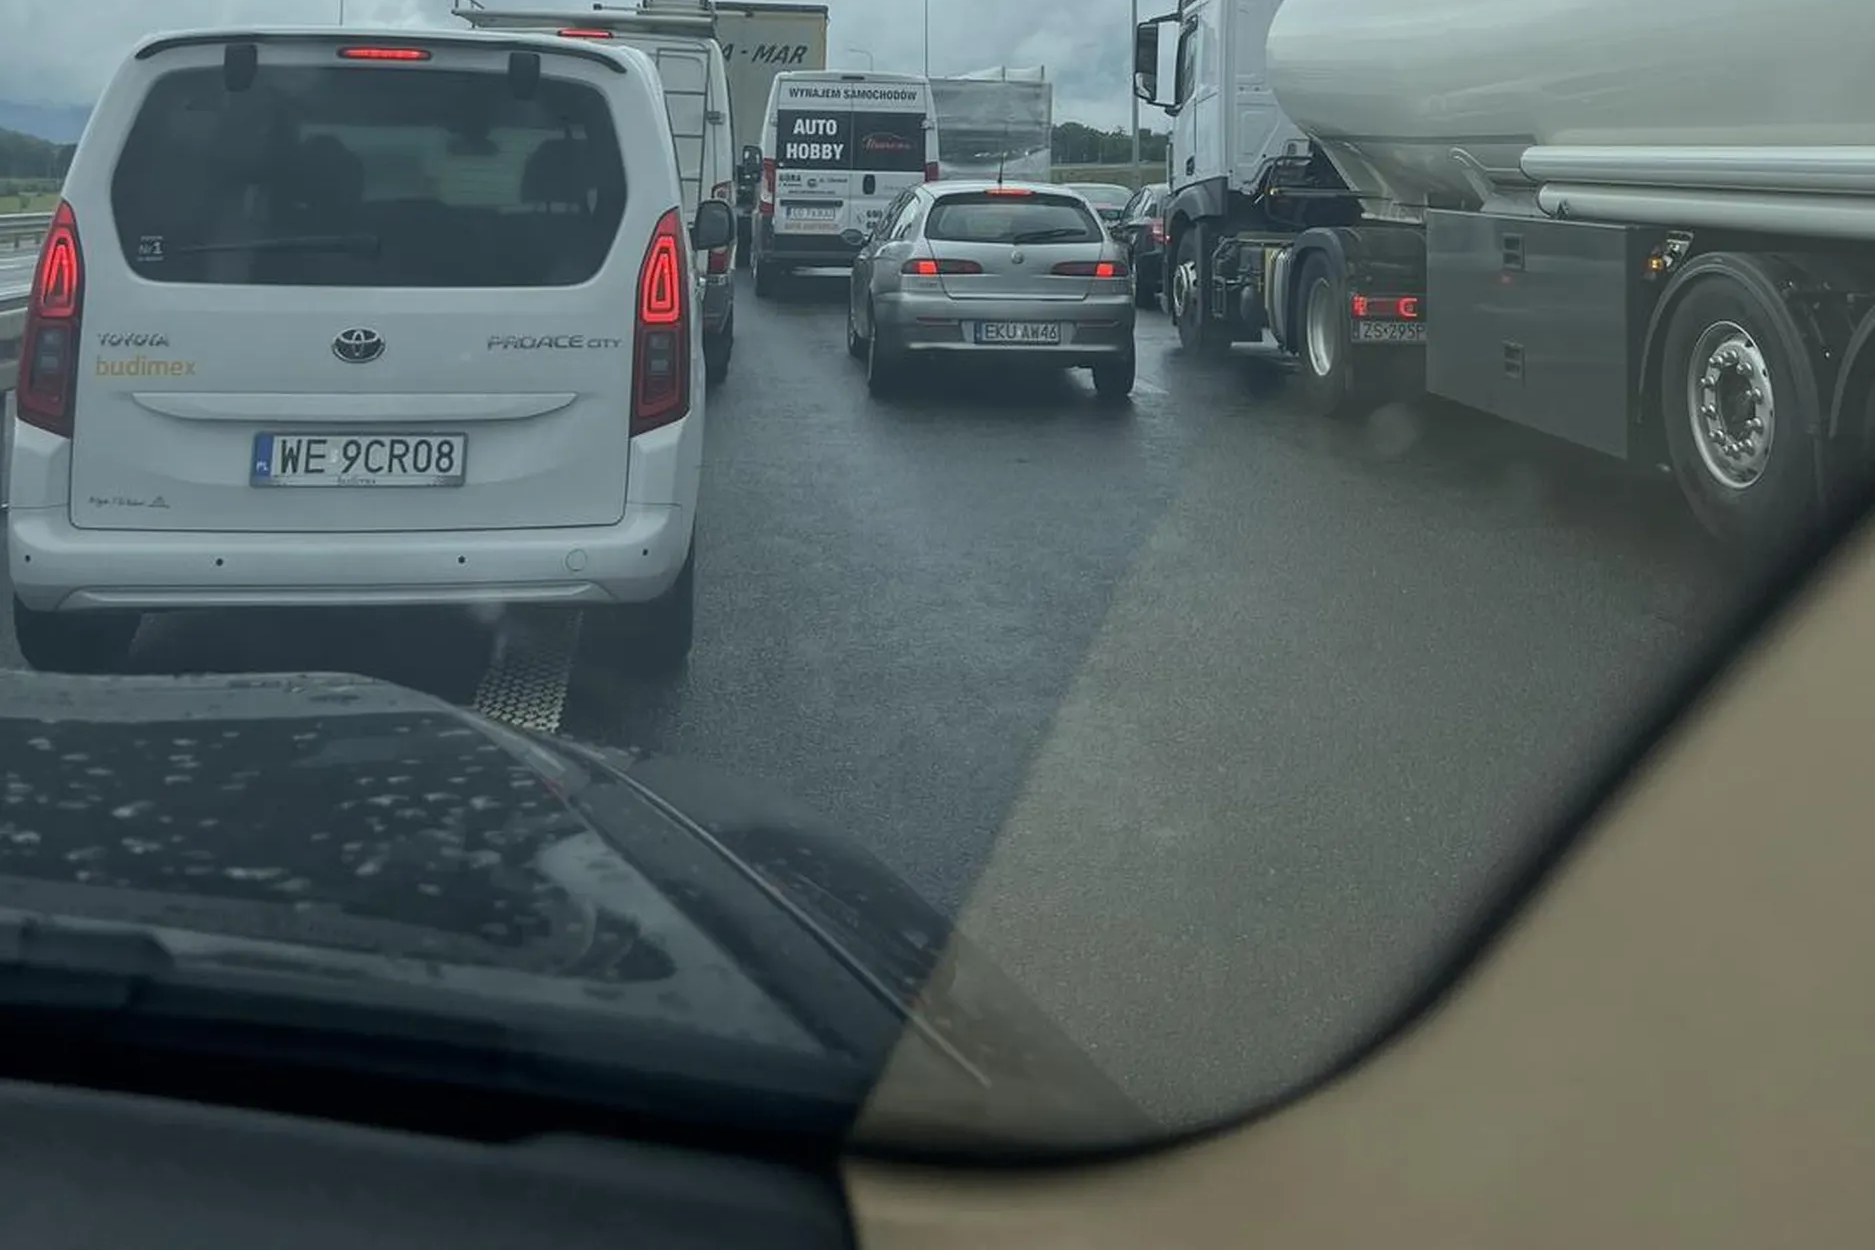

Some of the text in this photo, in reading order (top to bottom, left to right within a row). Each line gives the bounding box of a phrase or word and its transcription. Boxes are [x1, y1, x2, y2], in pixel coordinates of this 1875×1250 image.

[751, 44, 808, 64] MAR
[789, 88, 840, 99] WYNAJEM
[793, 118, 838, 136] AUTO
[786, 142, 844, 160] HOBBY
[97, 332, 169, 347] TOYOTA
[985, 324, 1017, 339] EKU
[487, 335, 622, 350] PROACE CITY
[96, 354, 195, 376] budimex
[281, 438, 454, 475] WE 9CR08
